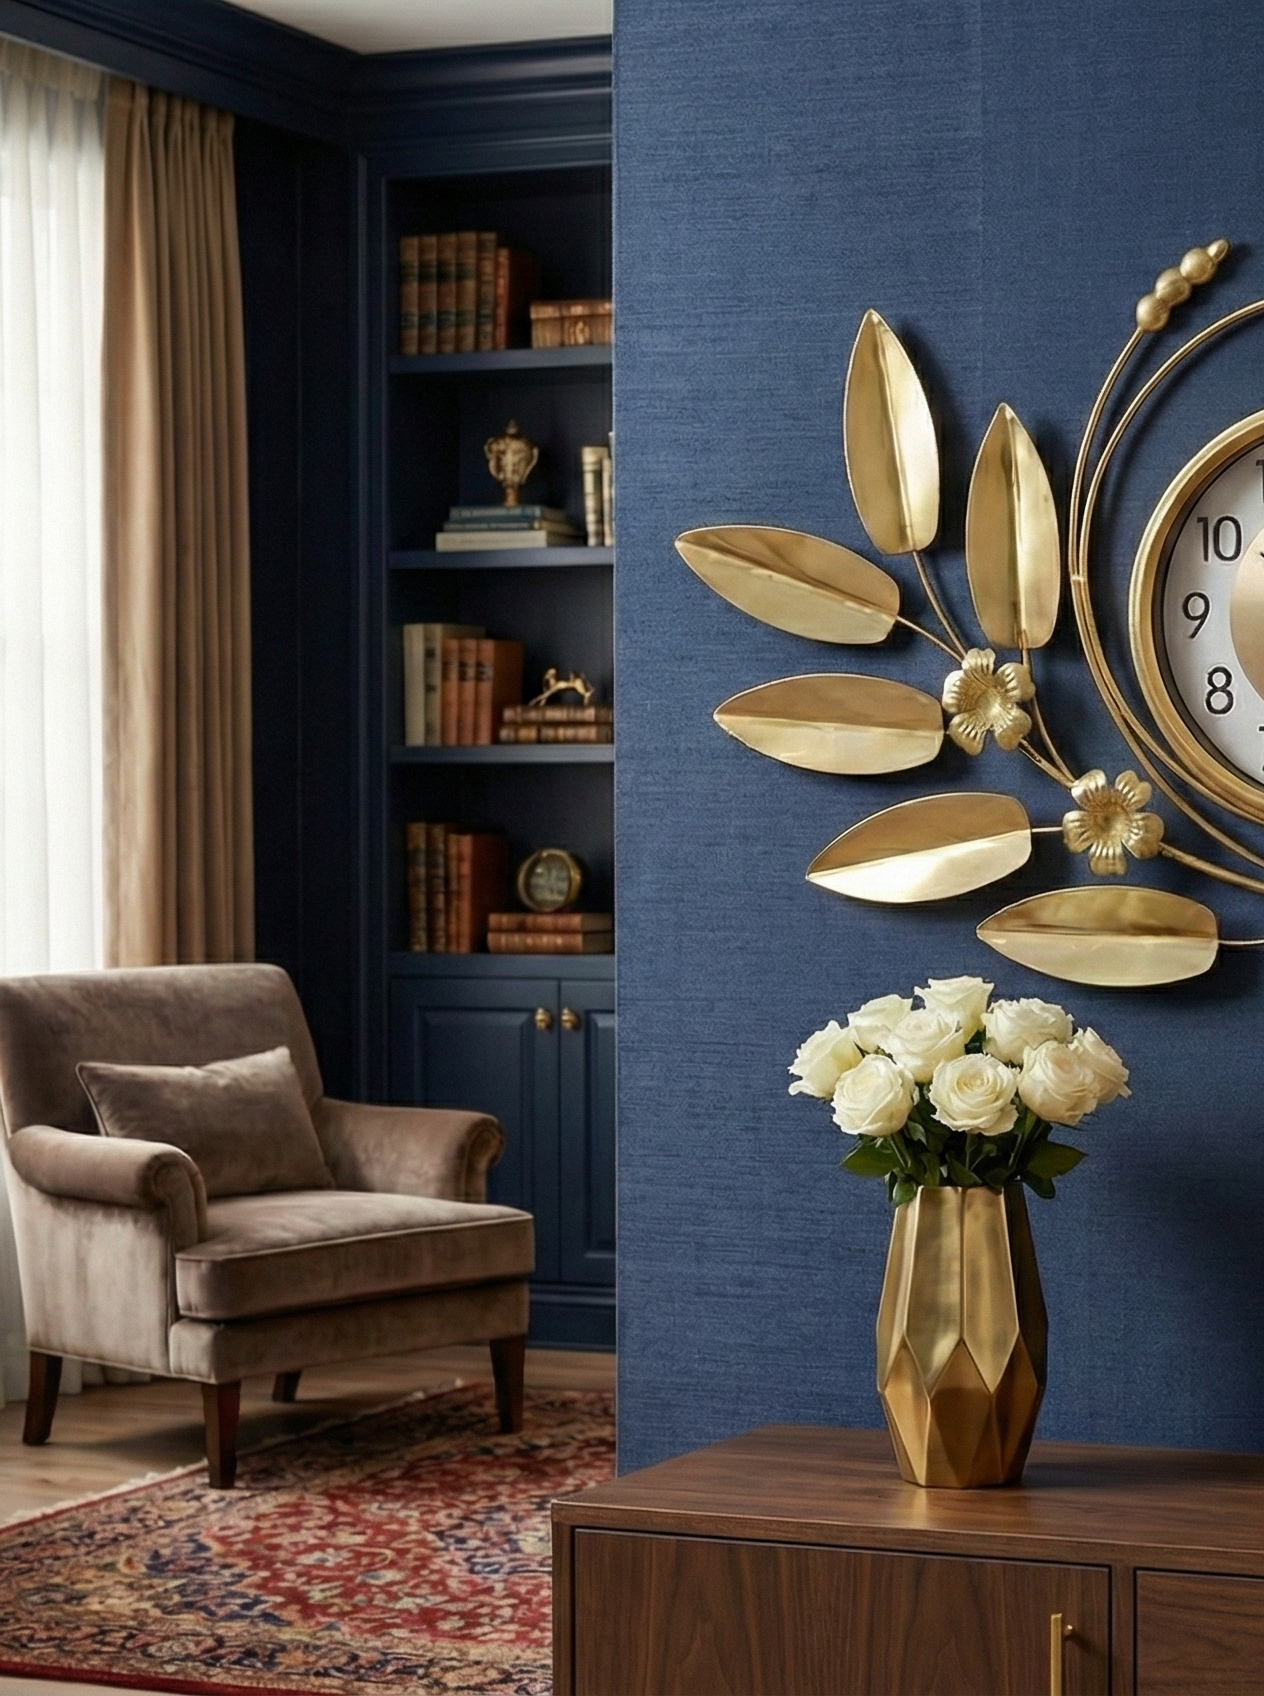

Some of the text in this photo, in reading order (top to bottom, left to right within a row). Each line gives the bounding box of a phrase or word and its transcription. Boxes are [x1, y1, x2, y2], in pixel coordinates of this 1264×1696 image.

[1197, 516, 1242, 561] 10
[1182, 592, 1210, 639] 9
[1205, 667, 1233, 714] 8
